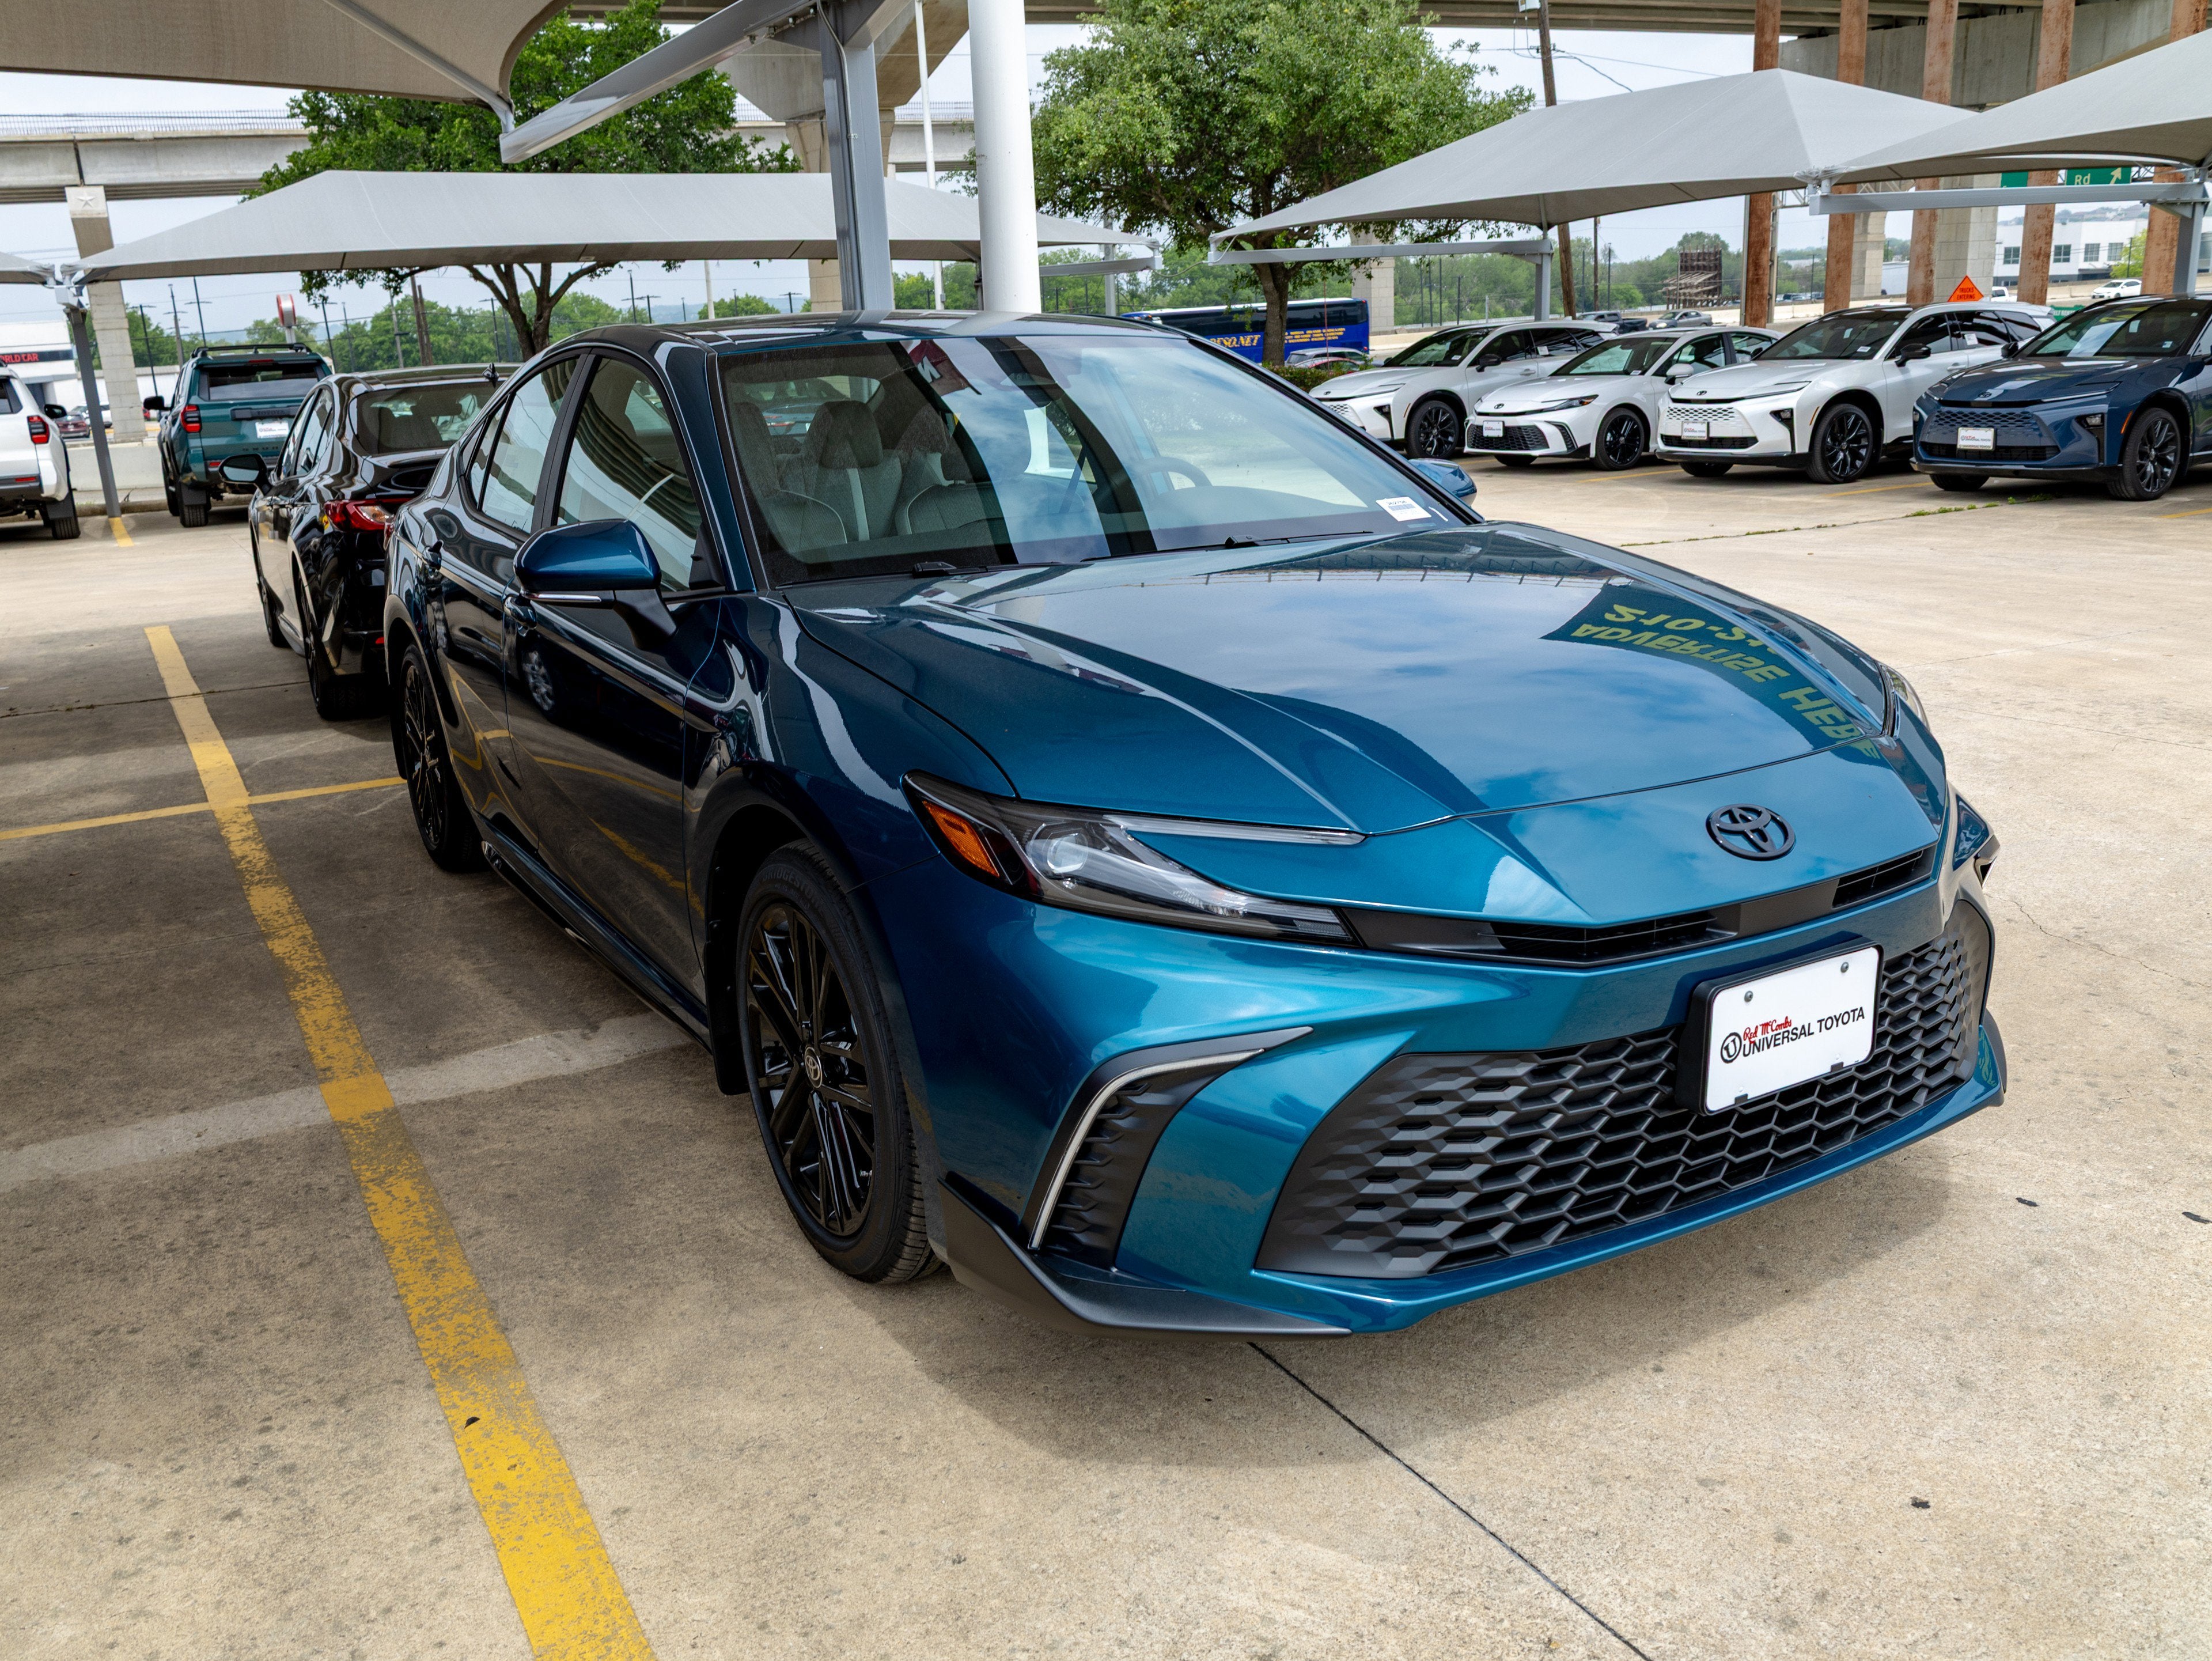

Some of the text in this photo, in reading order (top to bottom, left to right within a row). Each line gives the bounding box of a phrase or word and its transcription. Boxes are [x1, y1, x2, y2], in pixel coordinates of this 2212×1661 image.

[2074, 173, 2090, 185] Rd
[21, 353, 39, 362] CAR
[1743, 1016, 1791, 1043] Red McCombs
[1743, 1007, 1865, 1057] UNIVERSAL TOYOTA
